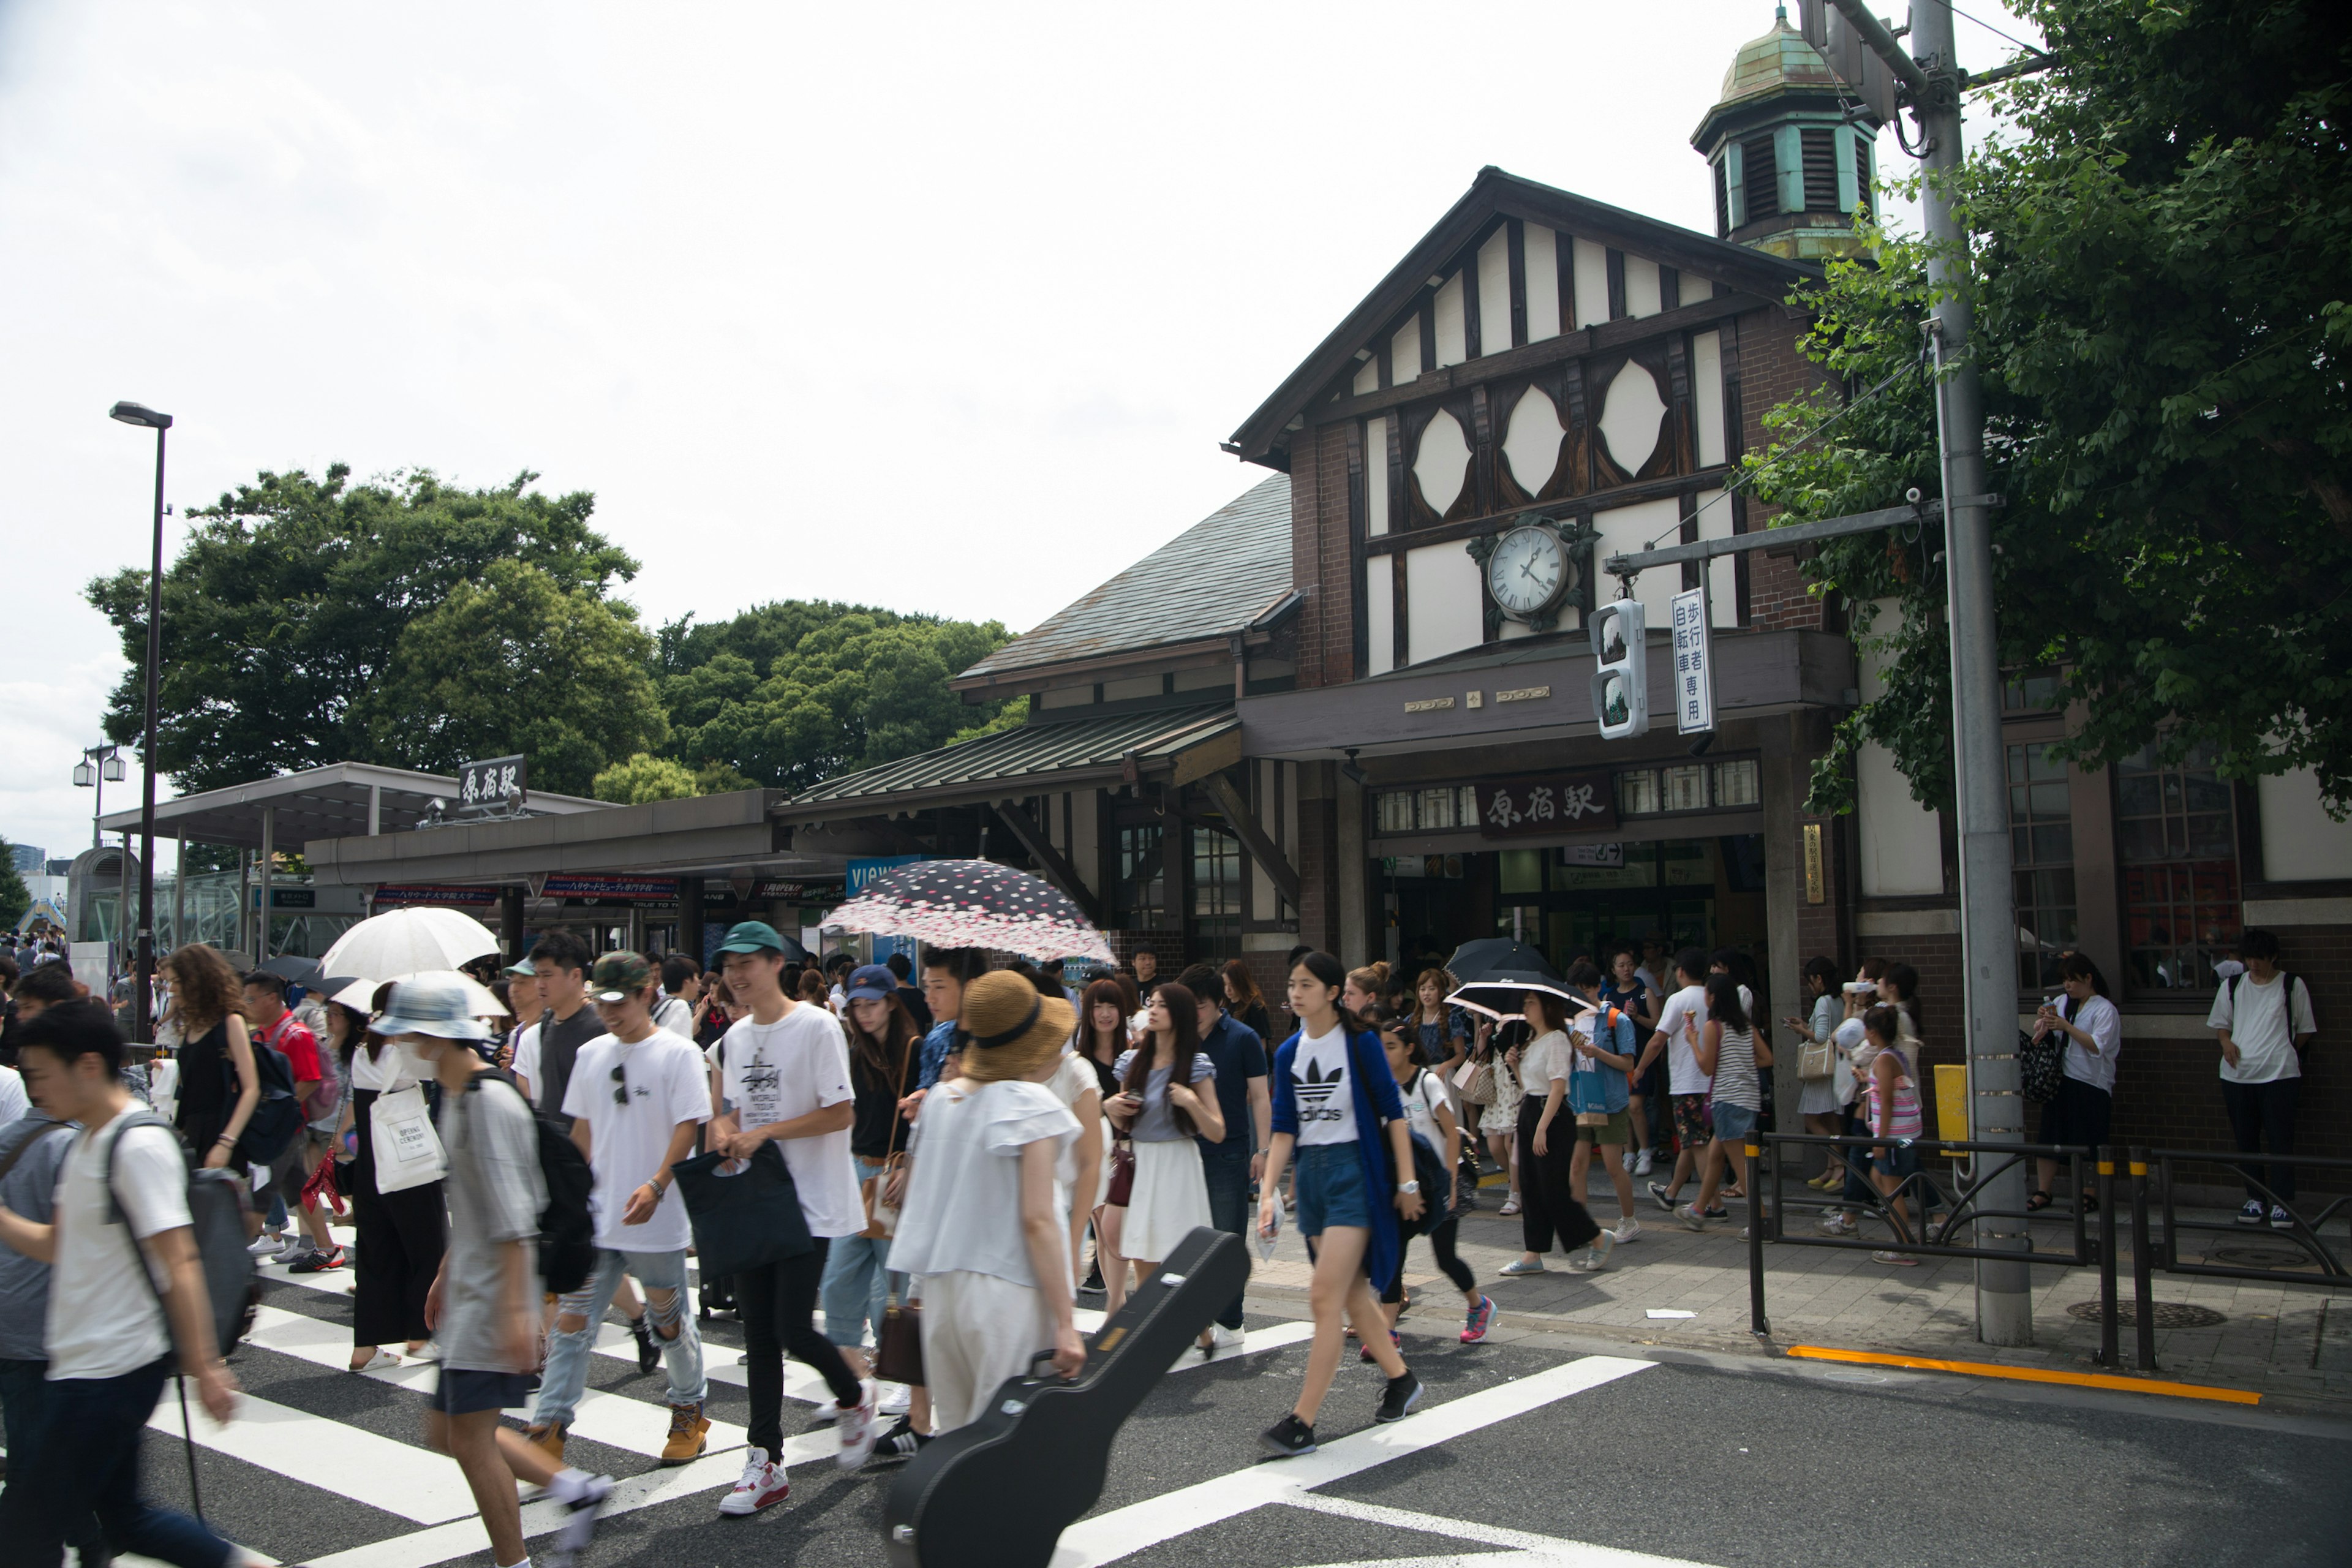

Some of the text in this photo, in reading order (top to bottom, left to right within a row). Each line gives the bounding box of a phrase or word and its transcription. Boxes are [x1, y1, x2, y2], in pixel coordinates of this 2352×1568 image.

[1676, 606, 1690, 674] 自転車
[1687, 603, 1702, 671] 歩行者
[1686, 676, 1698, 721] 専用
[462, 765, 518, 804] 原宿駅
[1486, 783, 1605, 828] 原宿駅
